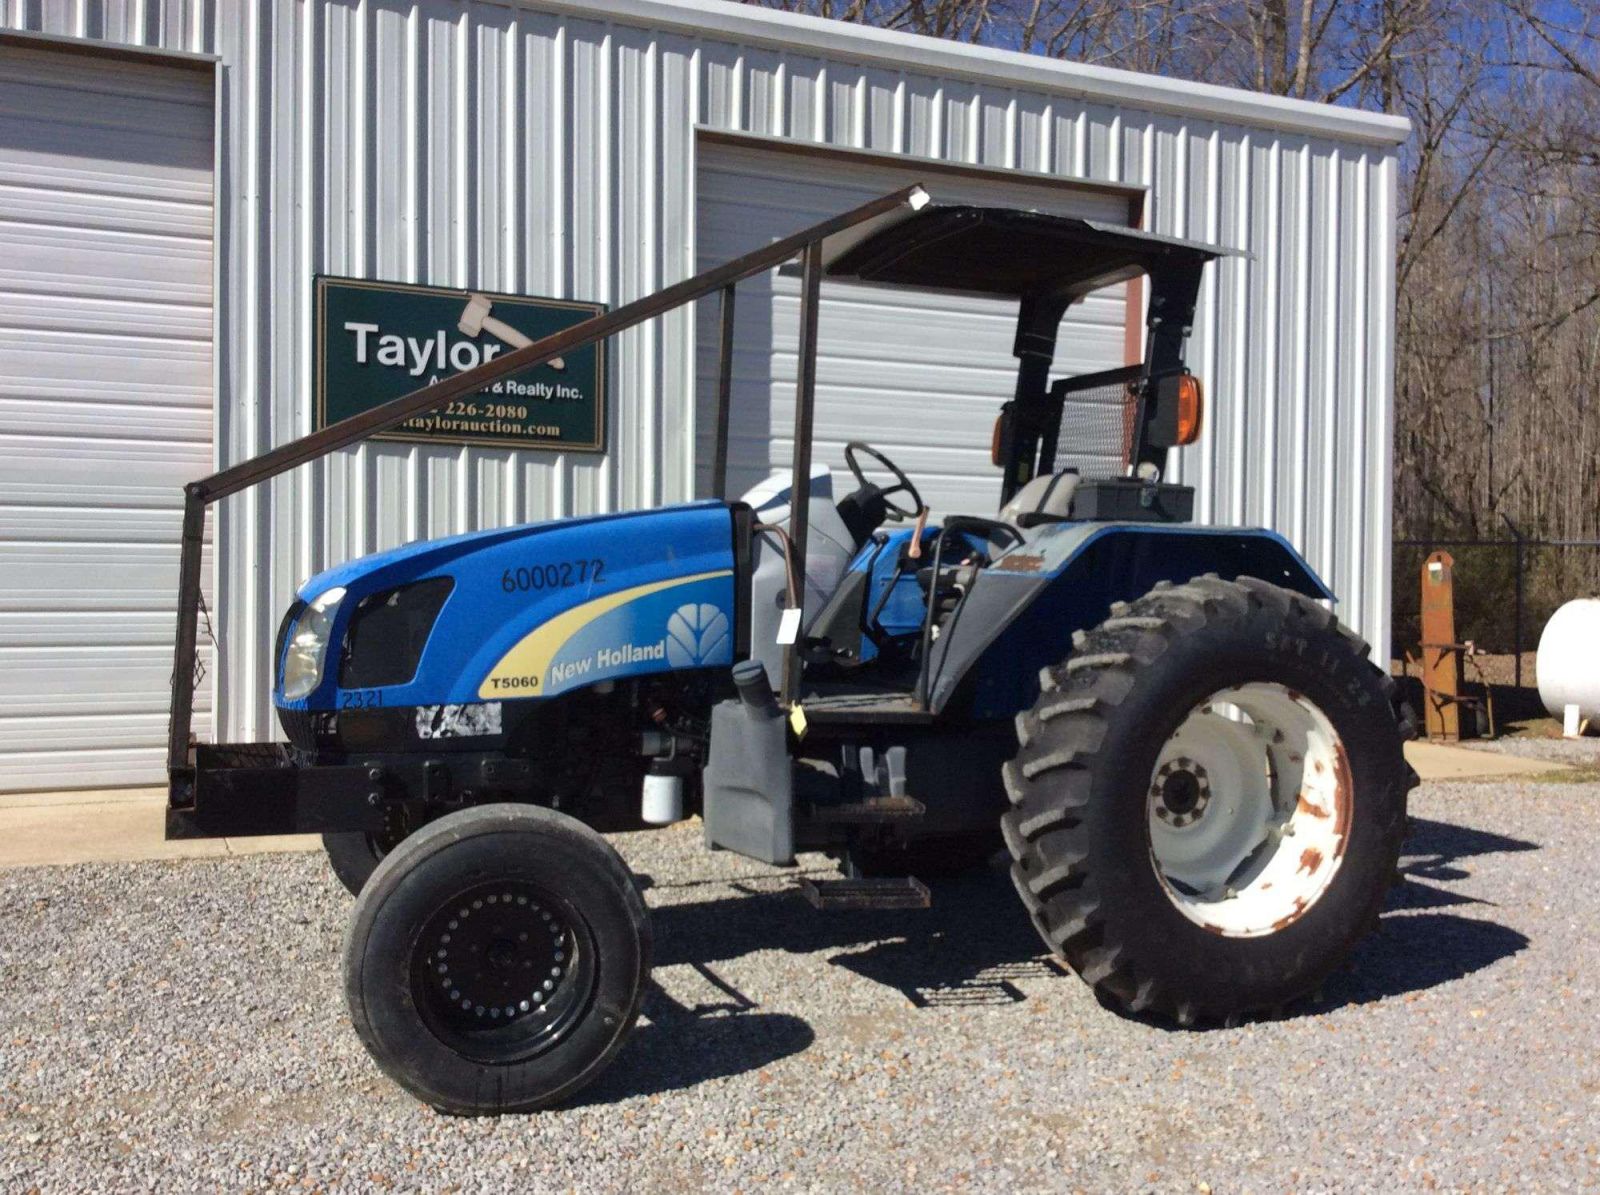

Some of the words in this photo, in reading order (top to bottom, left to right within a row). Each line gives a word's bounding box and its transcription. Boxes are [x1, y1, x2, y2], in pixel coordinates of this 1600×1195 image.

[344, 321, 501, 377] Taylor
[492, 382, 504, 394] &
[506, 380, 553, 400] Realty
[556, 386, 583, 399] Inc.
[445, 402, 528, 420] 226-2080
[403, 415, 561, 436] .taylorauction.com
[502, 560, 606, 593] 6000272
[551, 657, 593, 687] New
[597, 639, 665, 669] Holland
[491, 675, 539, 689] T5060
